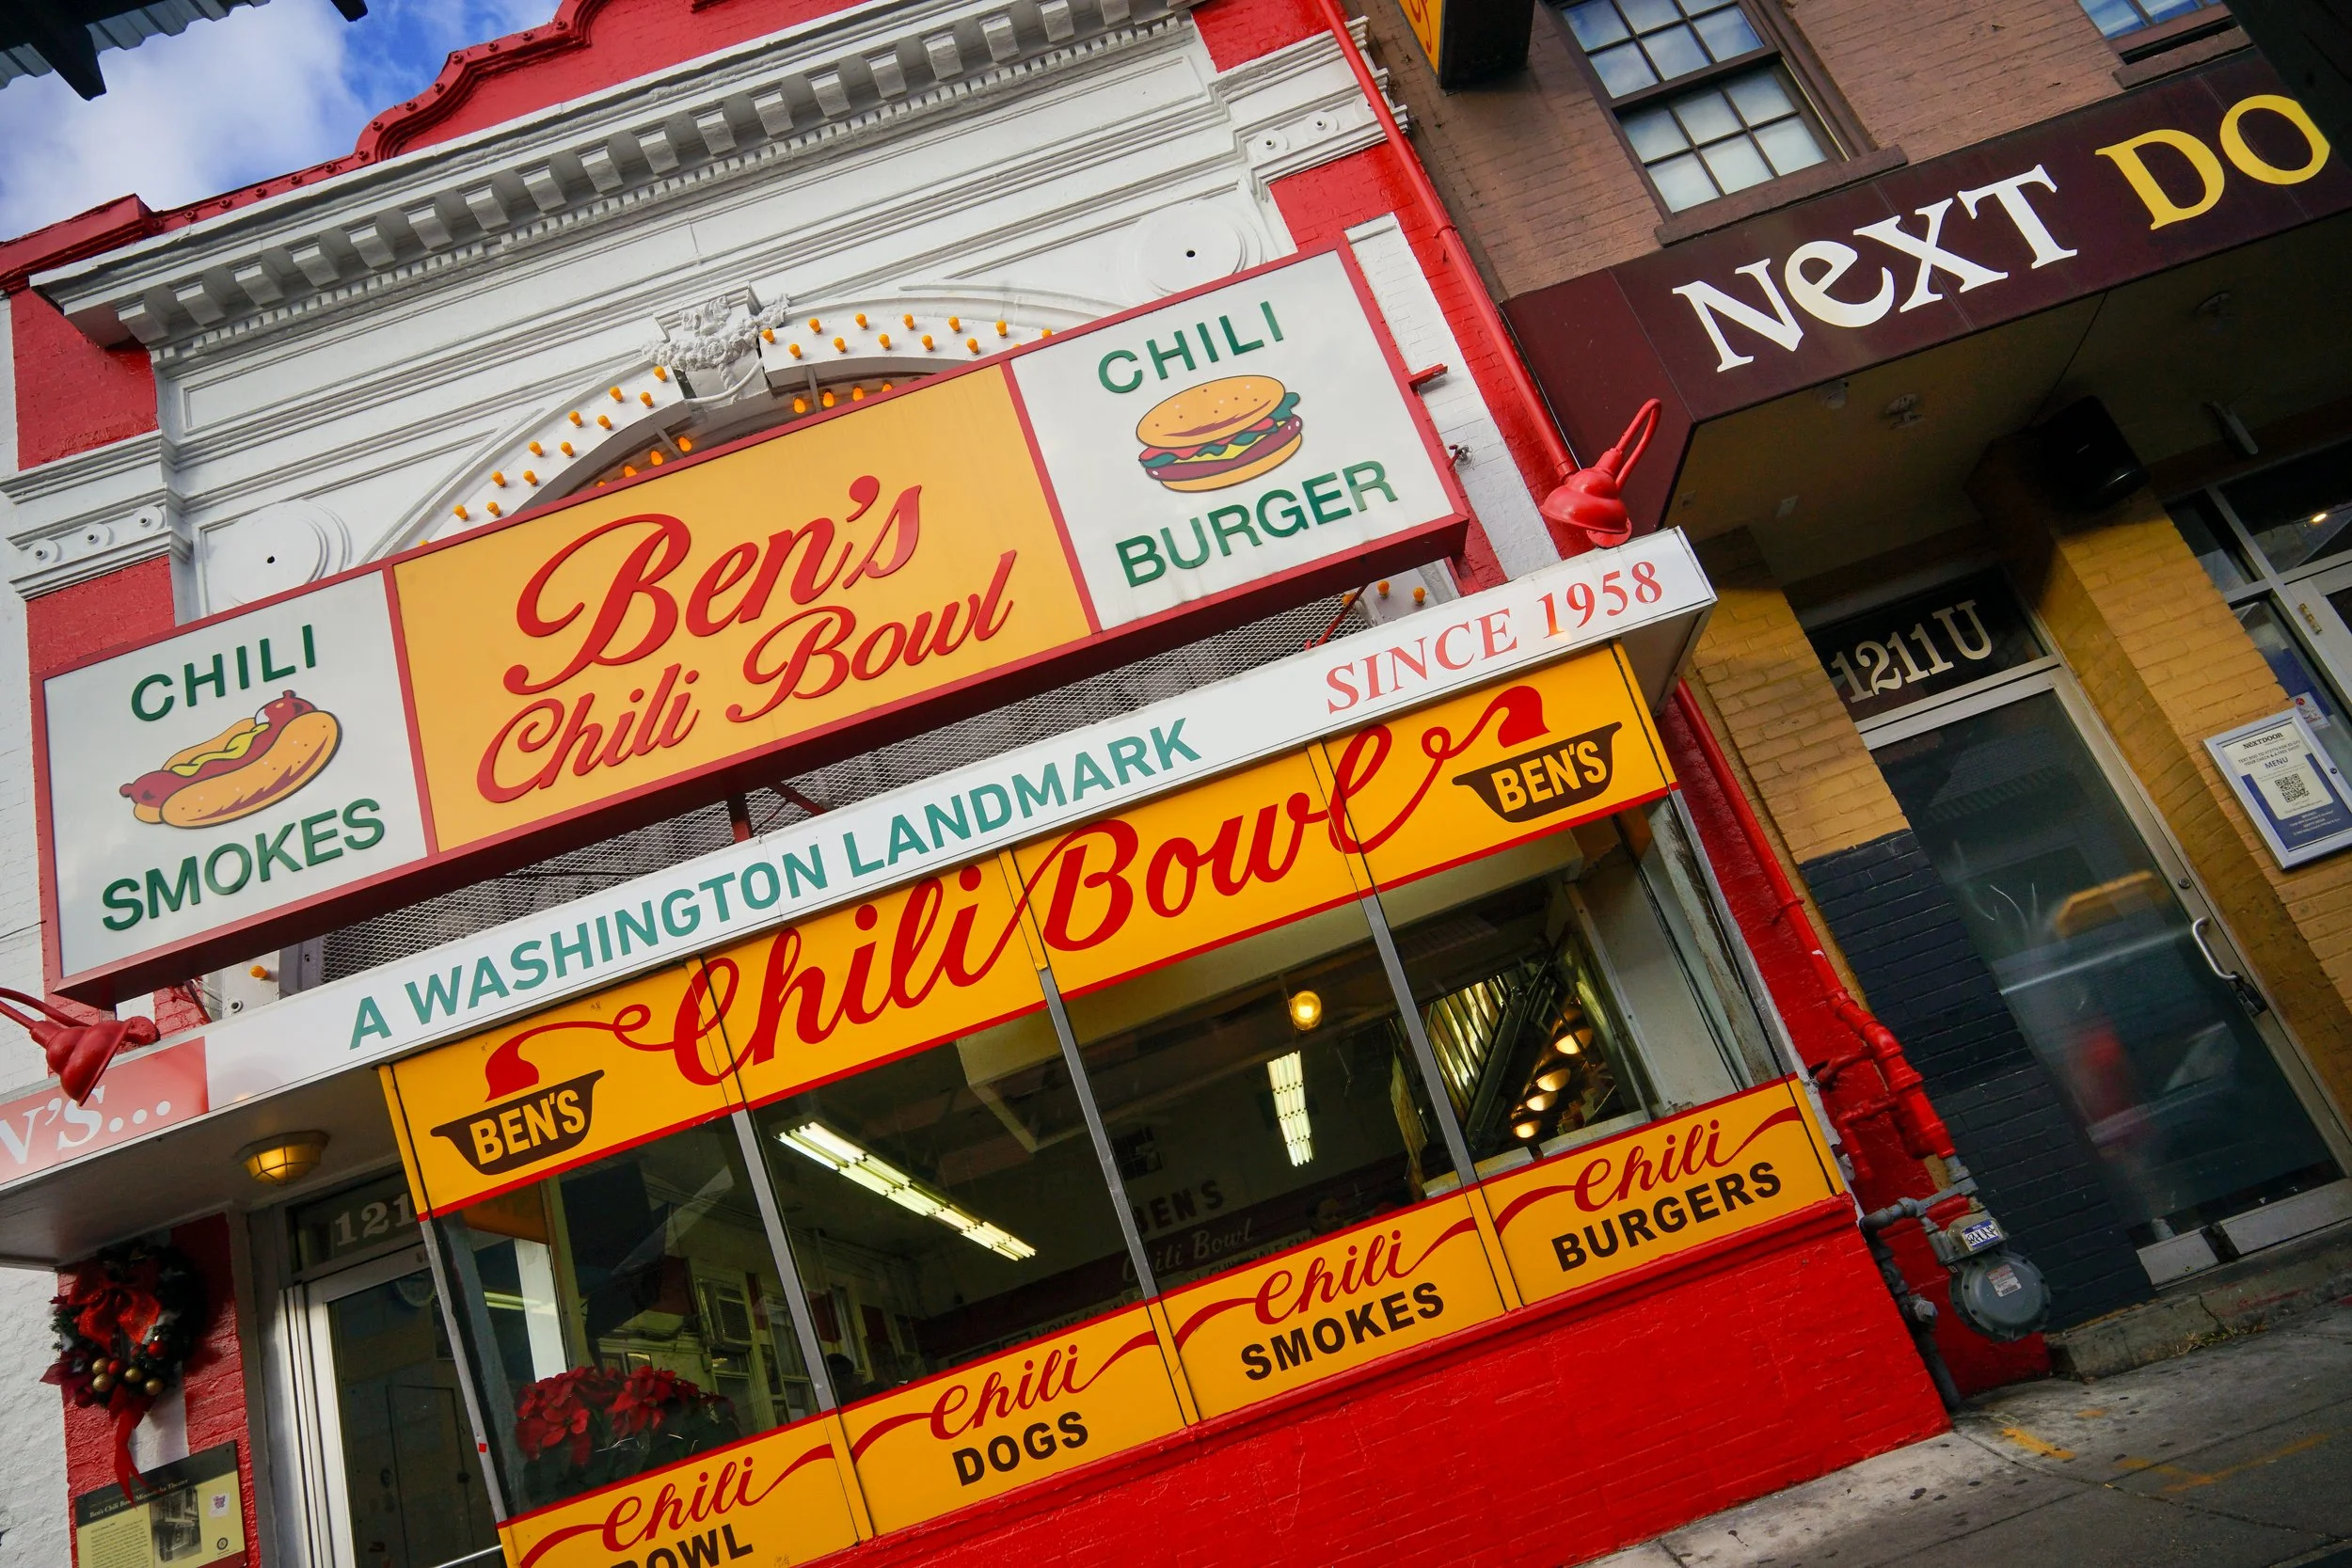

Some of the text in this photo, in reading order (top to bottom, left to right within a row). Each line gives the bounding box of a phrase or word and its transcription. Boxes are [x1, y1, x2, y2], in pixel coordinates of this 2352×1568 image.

[2095, 94, 2330, 231] DO
[1098, 300, 1284, 394] CHILI
[1115, 460, 1399, 588] BURGER
[502, 475, 923, 696] Ben's
[130, 624, 318, 722] CHILI
[476, 548, 1017, 804] Chili Bowl
[1831, 623, 1954, 704] 1211
[348, 561, 1663, 1051] A WASHINGTON LANDMARK SINCE 1958
[1491, 740, 1608, 815] BEN'S
[2265, 756, 2289, 769] MENU
[102, 798, 386, 932] SMOKES
[659, 723, 1430, 1087] Chili Bowl
[469, 1089, 585, 1165] BEN'S
[1573, 1119, 1729, 1213] Chili
[1121, 1217, 1254, 1283] Cili Bowl
[1551, 1161, 1782, 1273] BURGERS
[1253, 1229, 1416, 1326] Chili
[1241, 1282, 1445, 1381] SMOKES
[930, 1343, 1091, 1441] Chili
[952, 1410, 1089, 1487] DOGS
[602, 1456, 764, 1552] Chili
[610, 1523, 755, 1568] OWL
